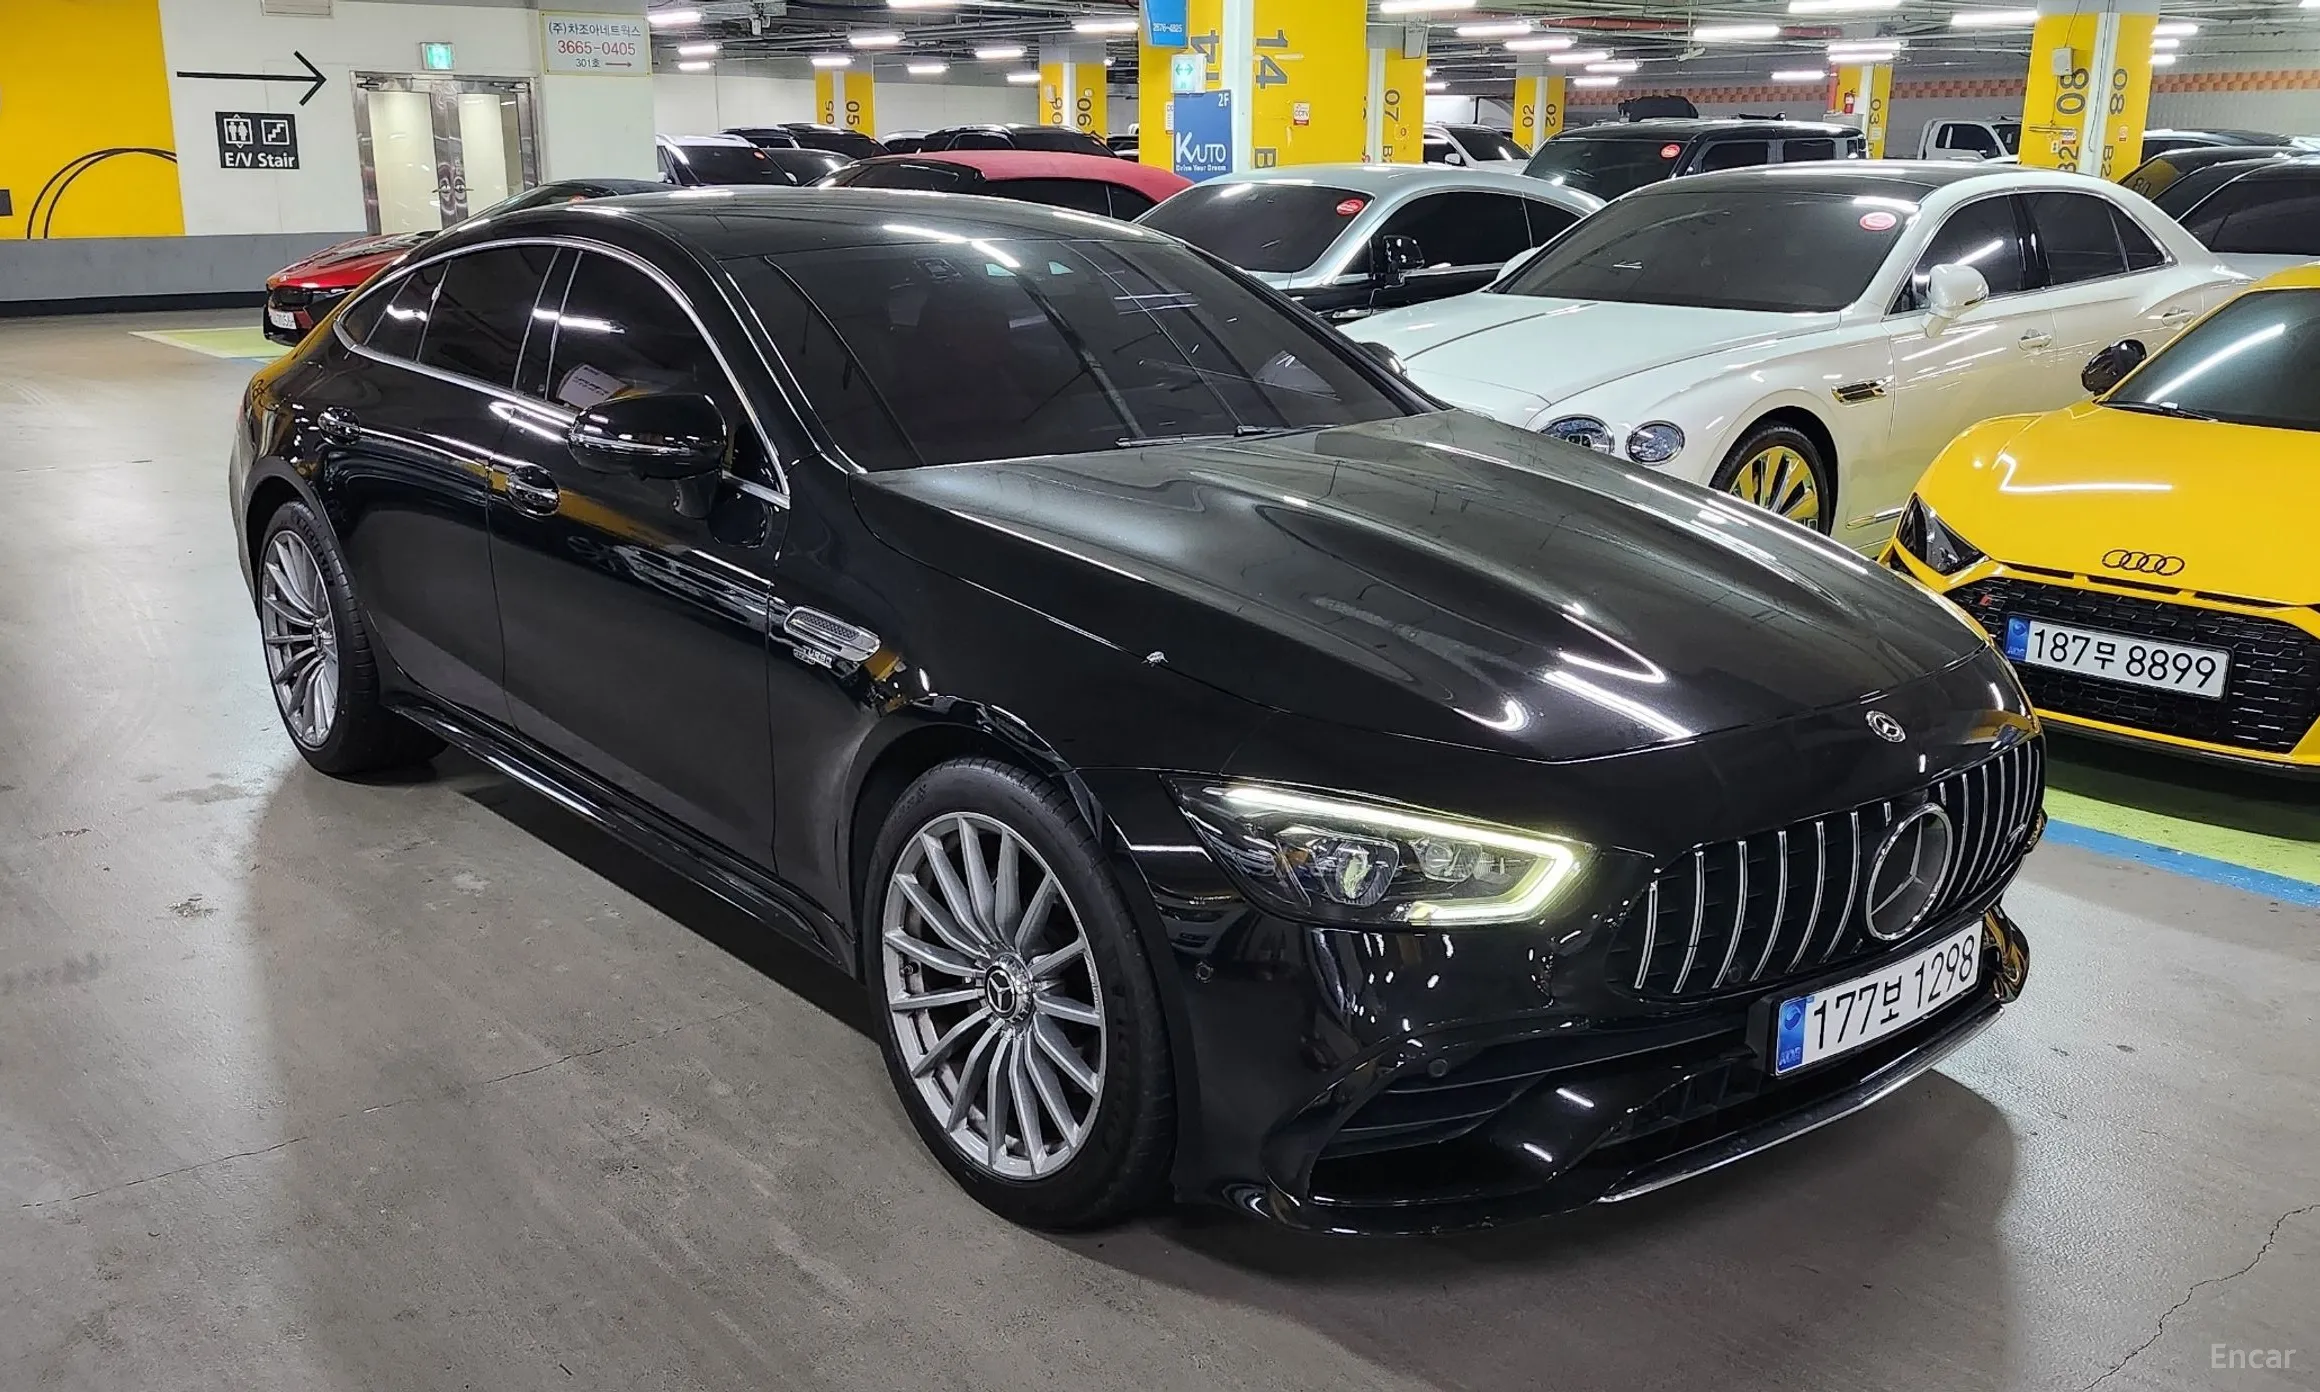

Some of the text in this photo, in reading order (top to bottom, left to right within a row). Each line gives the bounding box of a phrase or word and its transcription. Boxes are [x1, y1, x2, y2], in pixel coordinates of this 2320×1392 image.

[557, 40, 636, 55] 3665-0405
[575, 59, 600, 68] 301호
[1218, 93, 1230, 107] 2F
[2109, 68, 2128, 115] 08
[825, 100, 835, 125] 05
[846, 101, 860, 126] 05
[1077, 98, 1092, 126] 06
[1384, 89, 1400, 122] 07
[1522, 104, 1535, 128] 02
[1546, 103, 1556, 128] 02
[1871, 98, 1881, 125] 03
[224, 151, 295, 168] E/V Stair
[2034, 629, 2217, 688] 187무 8899
[1813, 935, 1975, 1050] 177보 1298
